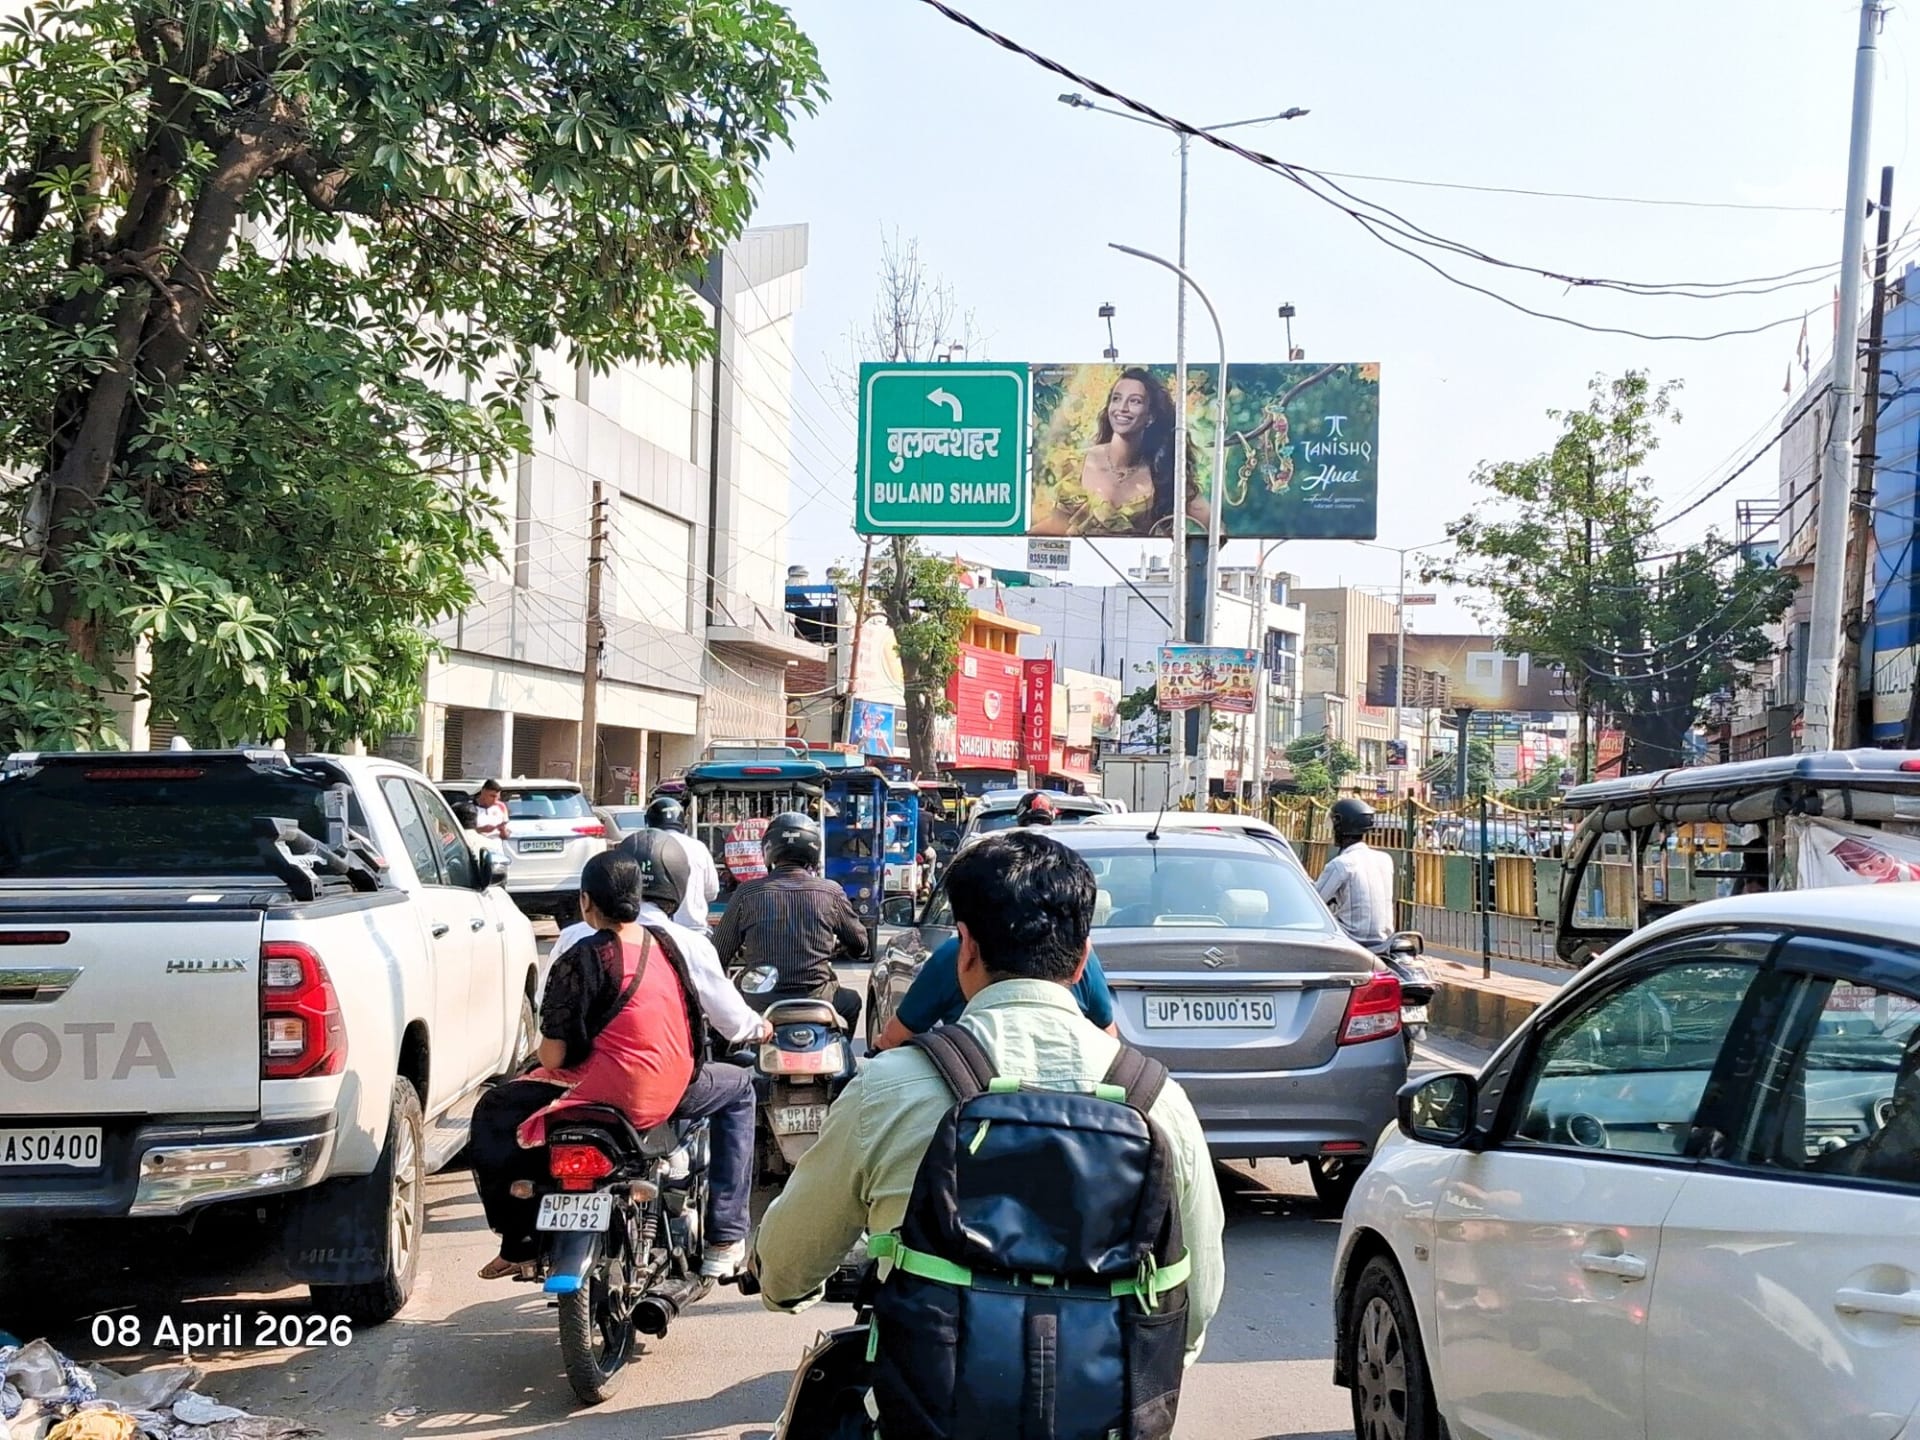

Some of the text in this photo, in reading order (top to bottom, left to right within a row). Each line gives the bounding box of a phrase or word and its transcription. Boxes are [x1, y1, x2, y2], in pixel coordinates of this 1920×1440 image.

[887, 427, 1001, 473] बुलन्दशहर
[1301, 464, 1360, 491] Hues
[874, 482, 1011, 503] BULAND SHAHR
[1032, 677, 1045, 751] SHAGUN
[959, 734, 990, 758] SHAGUN
[991, 738, 1020, 760] SWEETS
[733, 828, 764, 841] VIR
[166, 959, 249, 974] HILUX
[1158, 1001, 1273, 1021] UP16DU0150
[0, 1021, 177, 1082] OTA
[0, 1134, 98, 1162] AS0400
[550, 1212, 599, 1229] A0782
